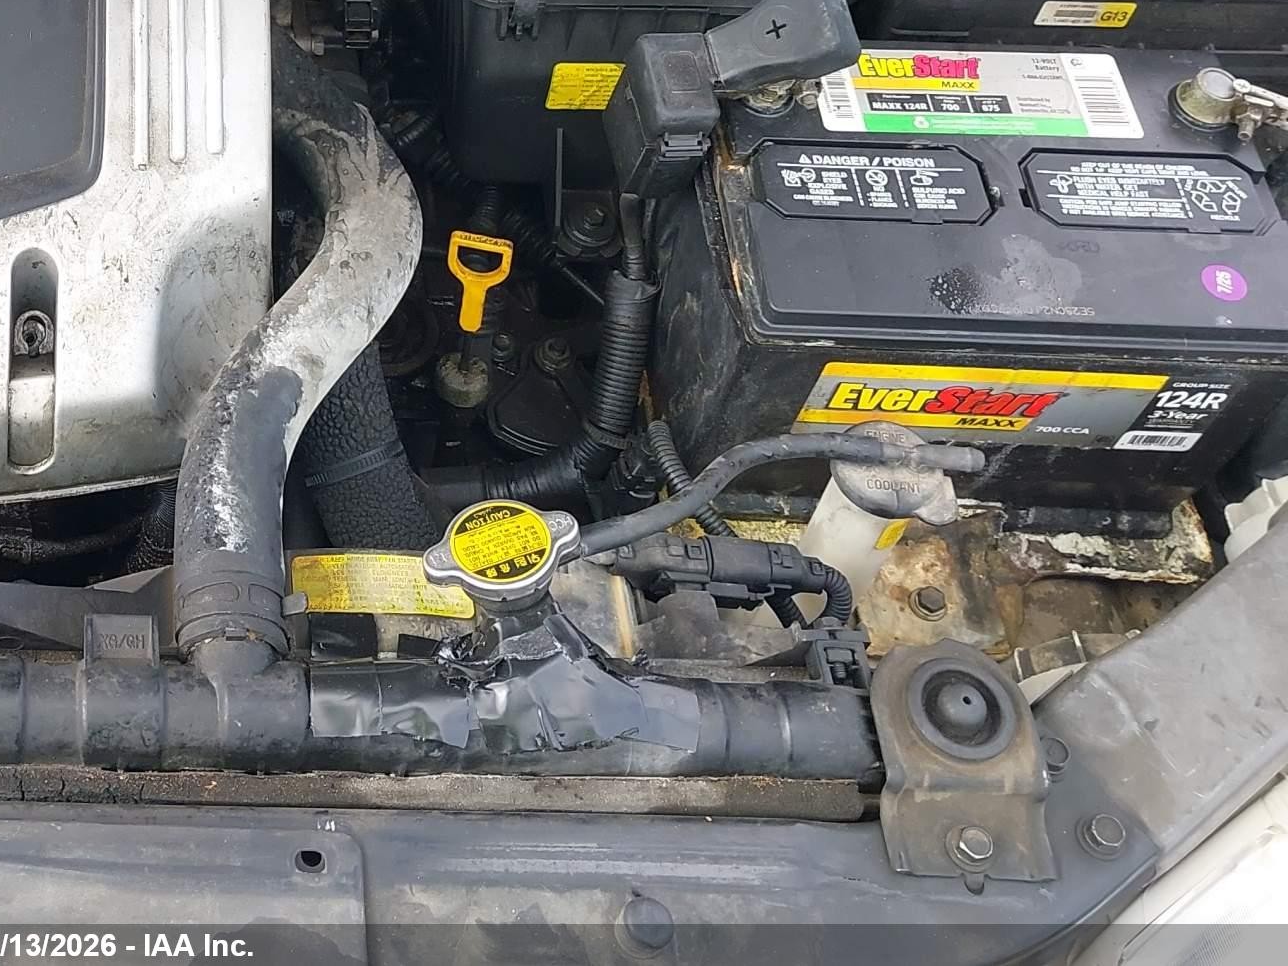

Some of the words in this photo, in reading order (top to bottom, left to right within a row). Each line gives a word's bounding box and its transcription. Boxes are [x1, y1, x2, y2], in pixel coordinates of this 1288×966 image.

[1100, 11, 1128, 22] G13
[858, 53, 979, 78] EverStart
[941, 81, 974, 89] MAXX
[813, 156, 870, 166] DANGER
[883, 157, 935, 167] POISON
[827, 381, 1062, 418] EverStart
[1156, 390, 1228, 410] 124R
[1147, 410, 1208, 420] 3-Year
[956, 417, 1022, 428] MAXX
[867, 478, 920, 493] COOLANT
[465, 509, 511, 531] CAUTION
